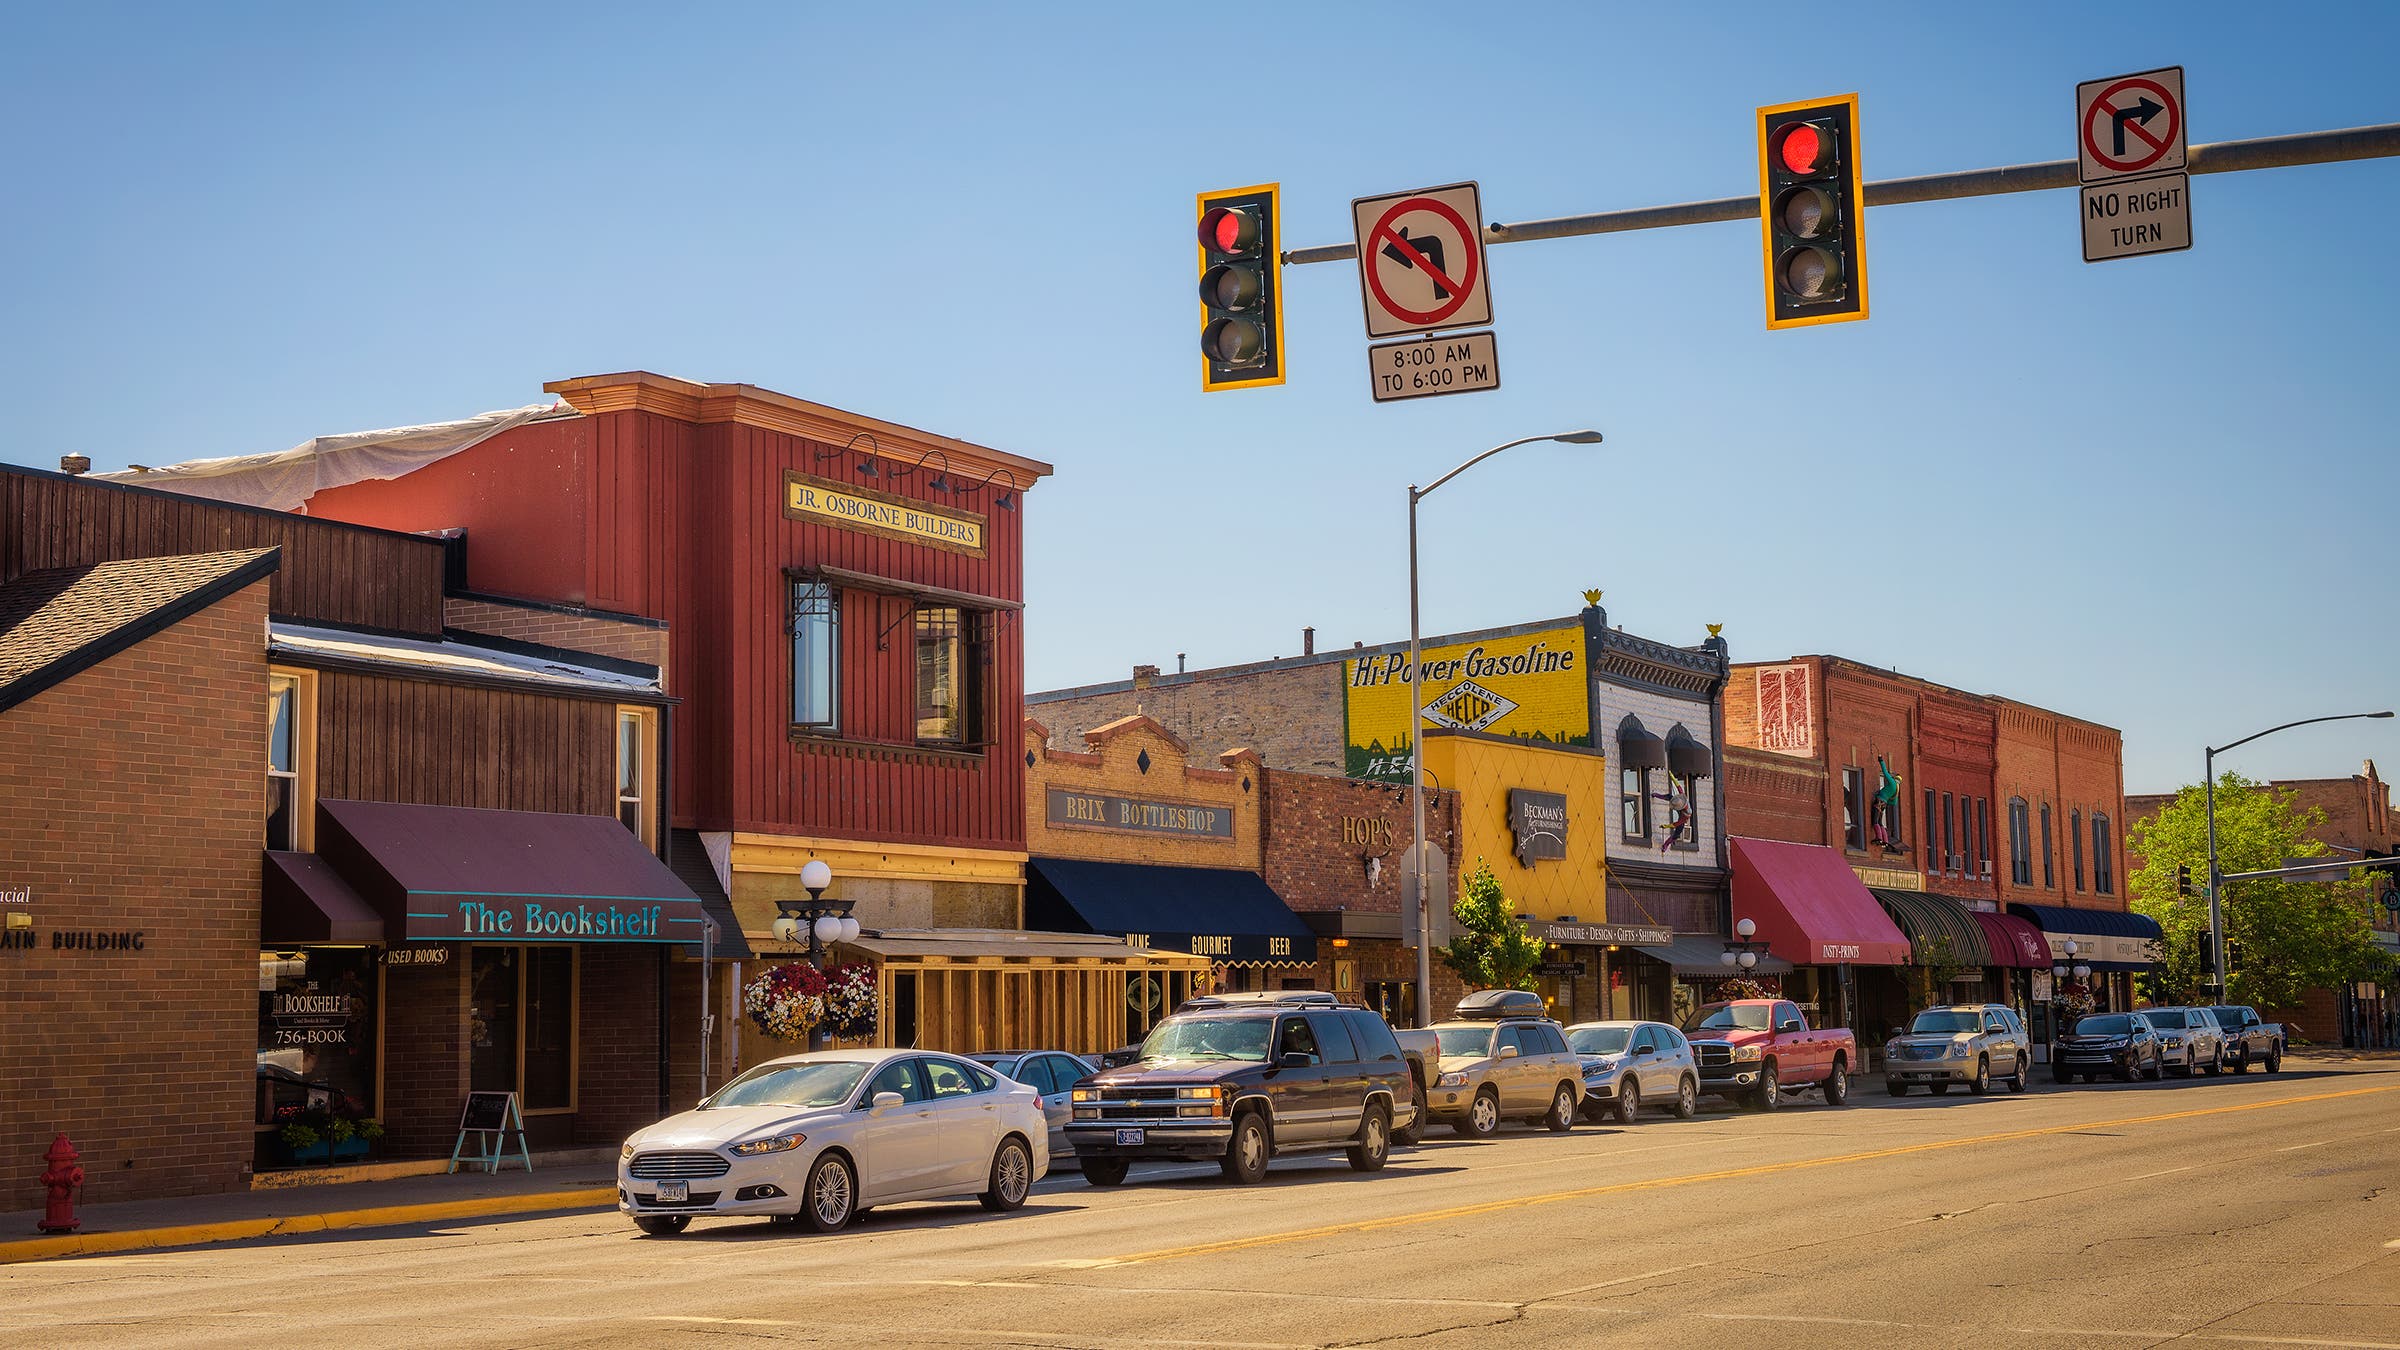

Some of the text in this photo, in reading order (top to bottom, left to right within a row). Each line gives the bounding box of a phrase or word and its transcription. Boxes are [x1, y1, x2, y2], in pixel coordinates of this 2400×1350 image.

[2089, 188, 2180, 219] NO RIGHT
[2110, 222, 2161, 247] TURN
[1394, 343, 1471, 368] 8:00 AM
[1382, 364, 1488, 392] TO 6:00 PM
[796, 488, 975, 543] JR. OSBORNE BUILDERS
[1465, 642, 1574, 678] Gasoline
[1430, 682, 1503, 711] HECCOLENE
[1447, 692, 1490, 725] HECCO
[1066, 796, 1215, 831] BRIX BOTTLESHOP
[1524, 802, 1563, 821] BECKMAN'S
[1341, 815, 1393, 847] HOP'S
[459, 901, 662, 936] The Bookshelf
[52, 931, 145, 950] BUILDING
[1126, 933, 1291, 956] WINE GOURMET BEER
[1549, 924, 1667, 943] FURNITURE DESIGN GIFTS SHIPPING
[388, 949, 444, 964] USED BOOKS
[1823, 944, 1860, 959] INSTY-PRINTS
[307, 981, 319, 990] THE
[285, 993, 340, 1013] BOOKSHELF
[274, 1029, 346, 1044] 756-BOOK
